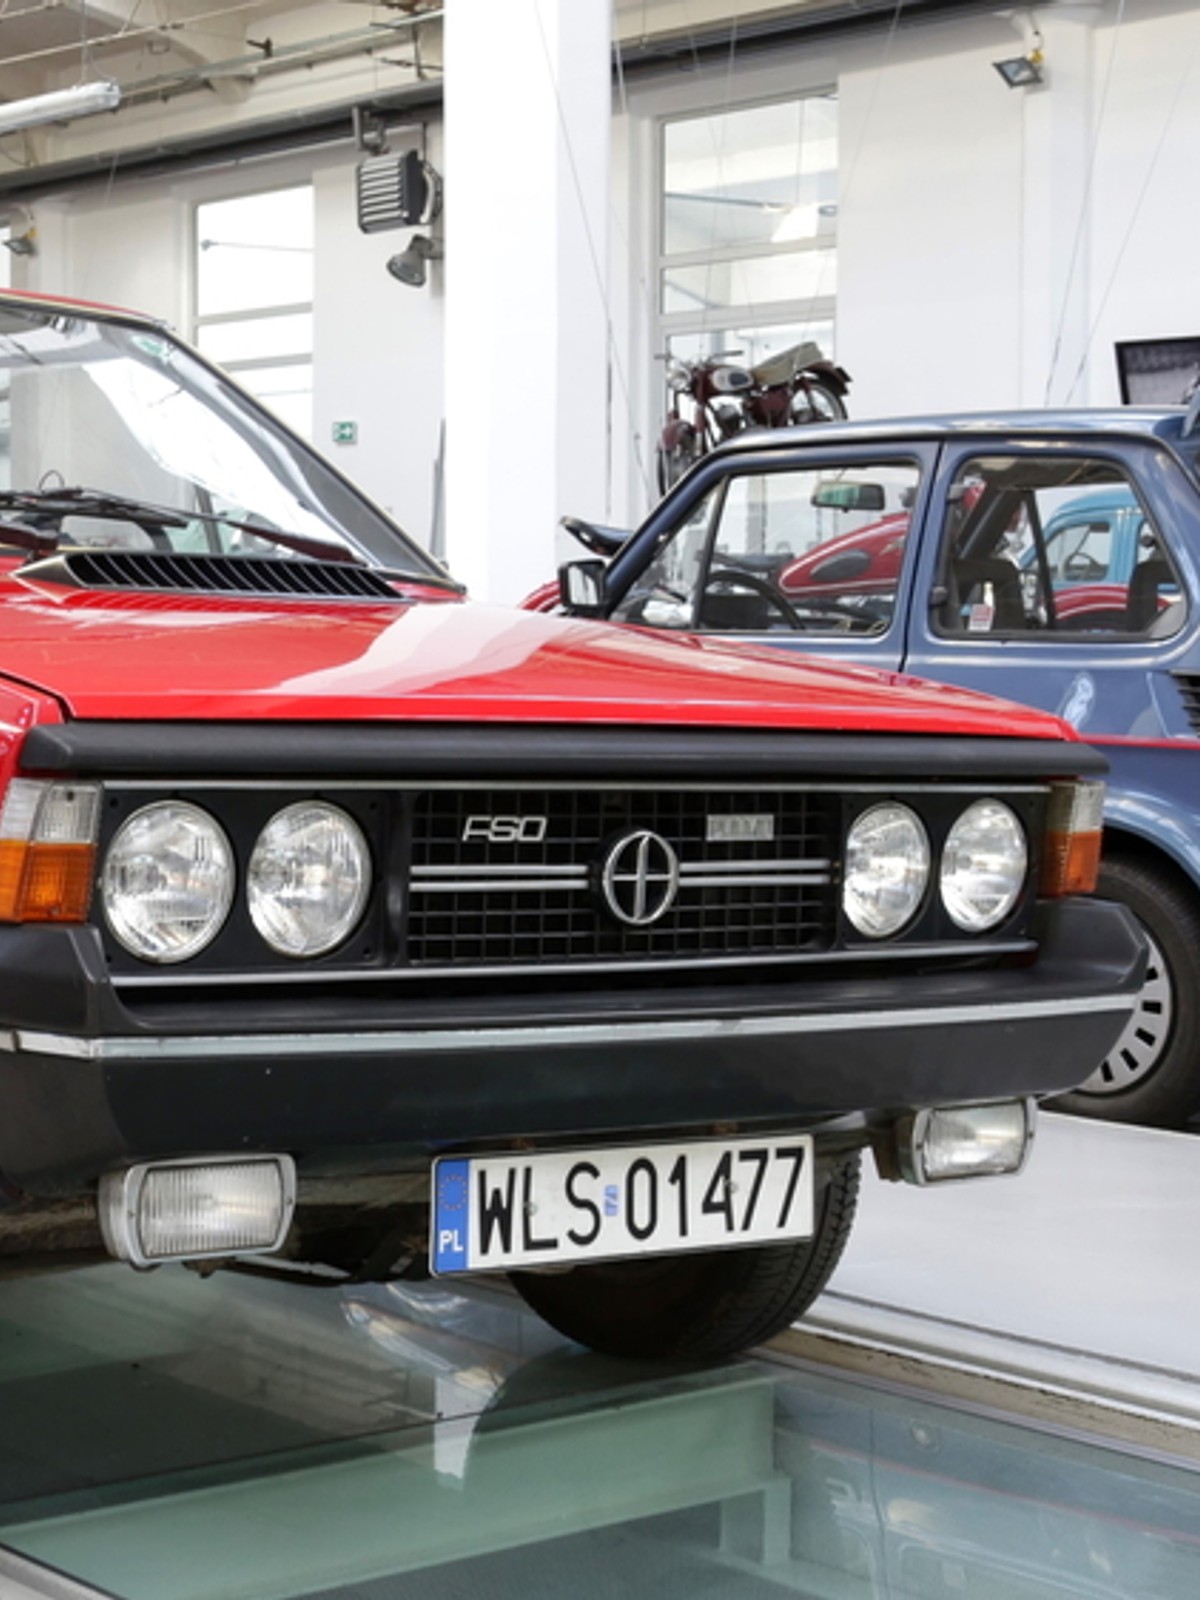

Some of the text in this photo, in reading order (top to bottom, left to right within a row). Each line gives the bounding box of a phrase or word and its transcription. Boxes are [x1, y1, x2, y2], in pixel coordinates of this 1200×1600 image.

[463, 816, 547, 842] FSO
[477, 1146, 804, 1256] WLS 01477
[438, 1230, 464, 1254] PL
